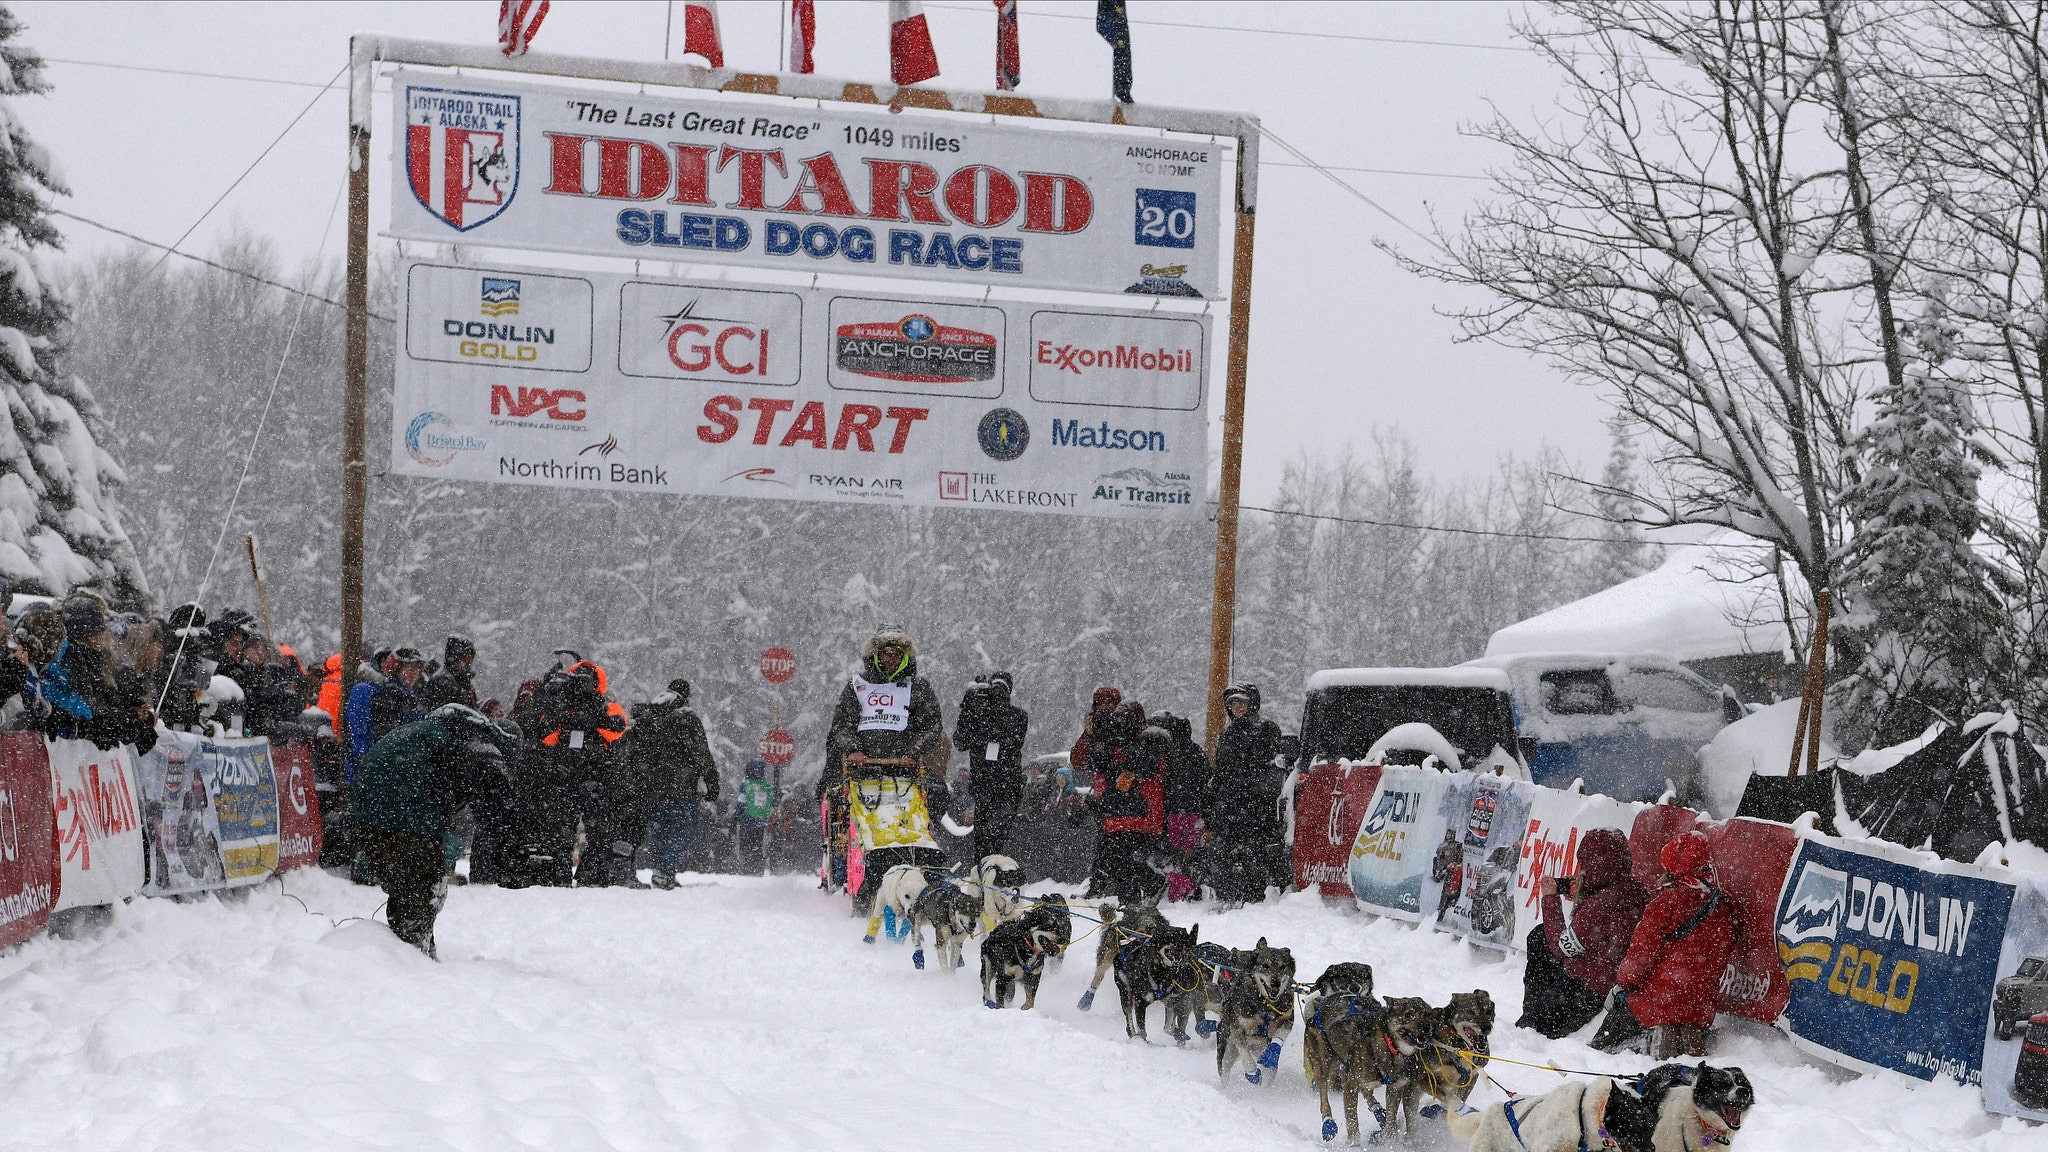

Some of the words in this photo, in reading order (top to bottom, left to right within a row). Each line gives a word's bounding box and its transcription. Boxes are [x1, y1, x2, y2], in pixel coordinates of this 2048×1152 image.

[478, 102, 513, 118] TRAIL
[566, 100, 618, 123] "The
[624, 108, 677, 130] Last
[682, 113, 744, 135] Great
[752, 118, 821, 141] Race"
[440, 113, 488, 130] ALASKA
[843, 125, 894, 149] 1049
[900, 132, 962, 153] miles
[1126, 146, 1208, 163] ANCHORAGE
[541, 131, 1095, 234] IDITAROD
[616, 208, 752, 252] SLED
[764, 219, 877, 264] DOG
[888, 228, 1024, 274] RACE
[443, 318, 555, 345] DONLIN
[459, 340, 538, 362] GOLD
[667, 323, 769, 376] GCI
[843, 341, 990, 363] ANCHORAGE
[1037, 340, 1193, 375] ExxonMobil
[490, 384, 587, 422] NAC
[489, 418, 538, 430] NORTHERN
[696, 394, 930, 455] START
[427, 433, 464, 448] Bristol
[465, 437, 488, 451] Bay
[1052, 418, 1166, 453] Matson
[499, 456, 600, 482] Northrim
[610, 463, 668, 486] Bank
[809, 474, 864, 488] RYAN
[871, 478, 903, 490] AIR
[972, 472, 998, 485] THE
[1164, 472, 1191, 481] Alaska
[972, 489, 1078, 508] LAKEFRONT
[1092, 485, 1123, 500] Air
[1126, 486, 1191, 504] Transit
[761, 658, 796, 673] STOP
[867, 694, 894, 707] GCI
[759, 742, 794, 756] STOP
[1846, 875, 1975, 957] DONLIN
[1827, 942, 1920, 1014] GOLD
